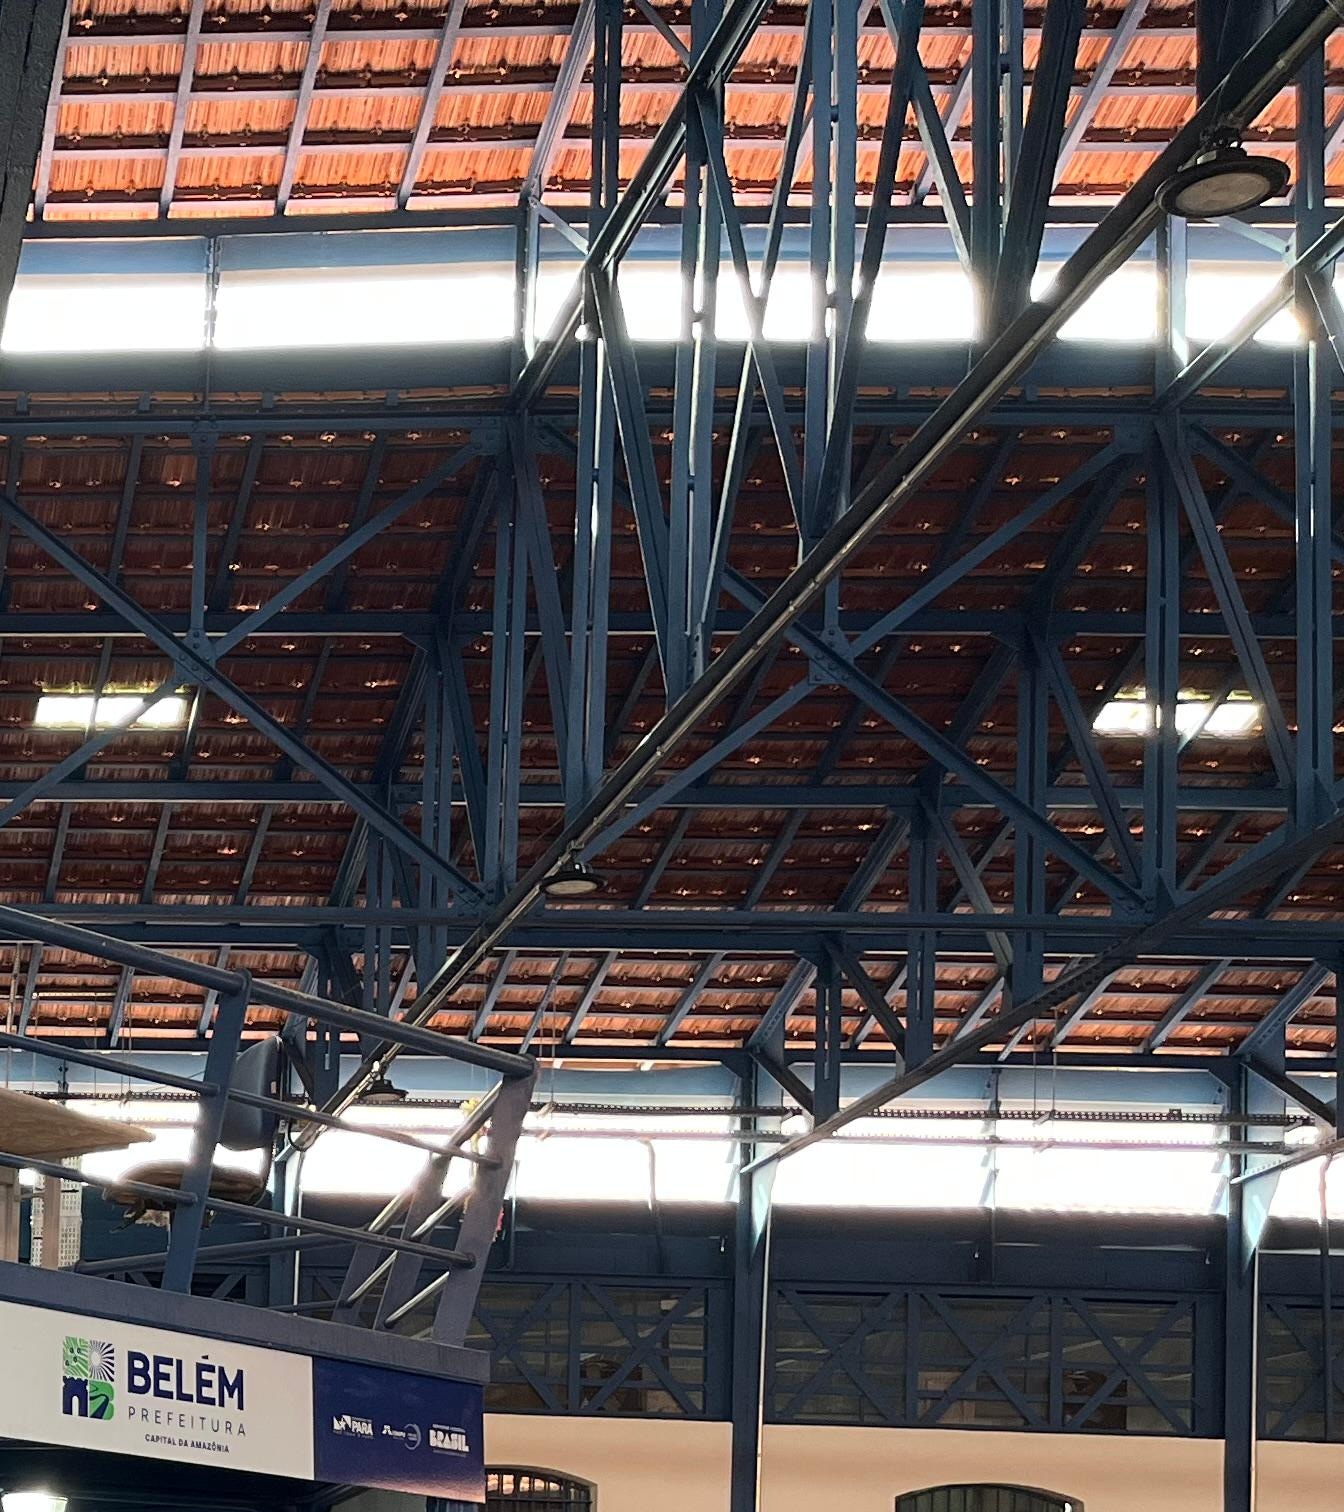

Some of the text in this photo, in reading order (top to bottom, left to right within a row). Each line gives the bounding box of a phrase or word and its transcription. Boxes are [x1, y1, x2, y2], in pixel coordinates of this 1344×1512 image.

[127, 1350, 244, 1411] BELÉM
[128, 1406, 246, 1436] PREFEITURA
[145, 1433, 230, 1453] CAPITAL DA AMAZÔNIA
[429, 1429, 469, 1452] BRASIL
